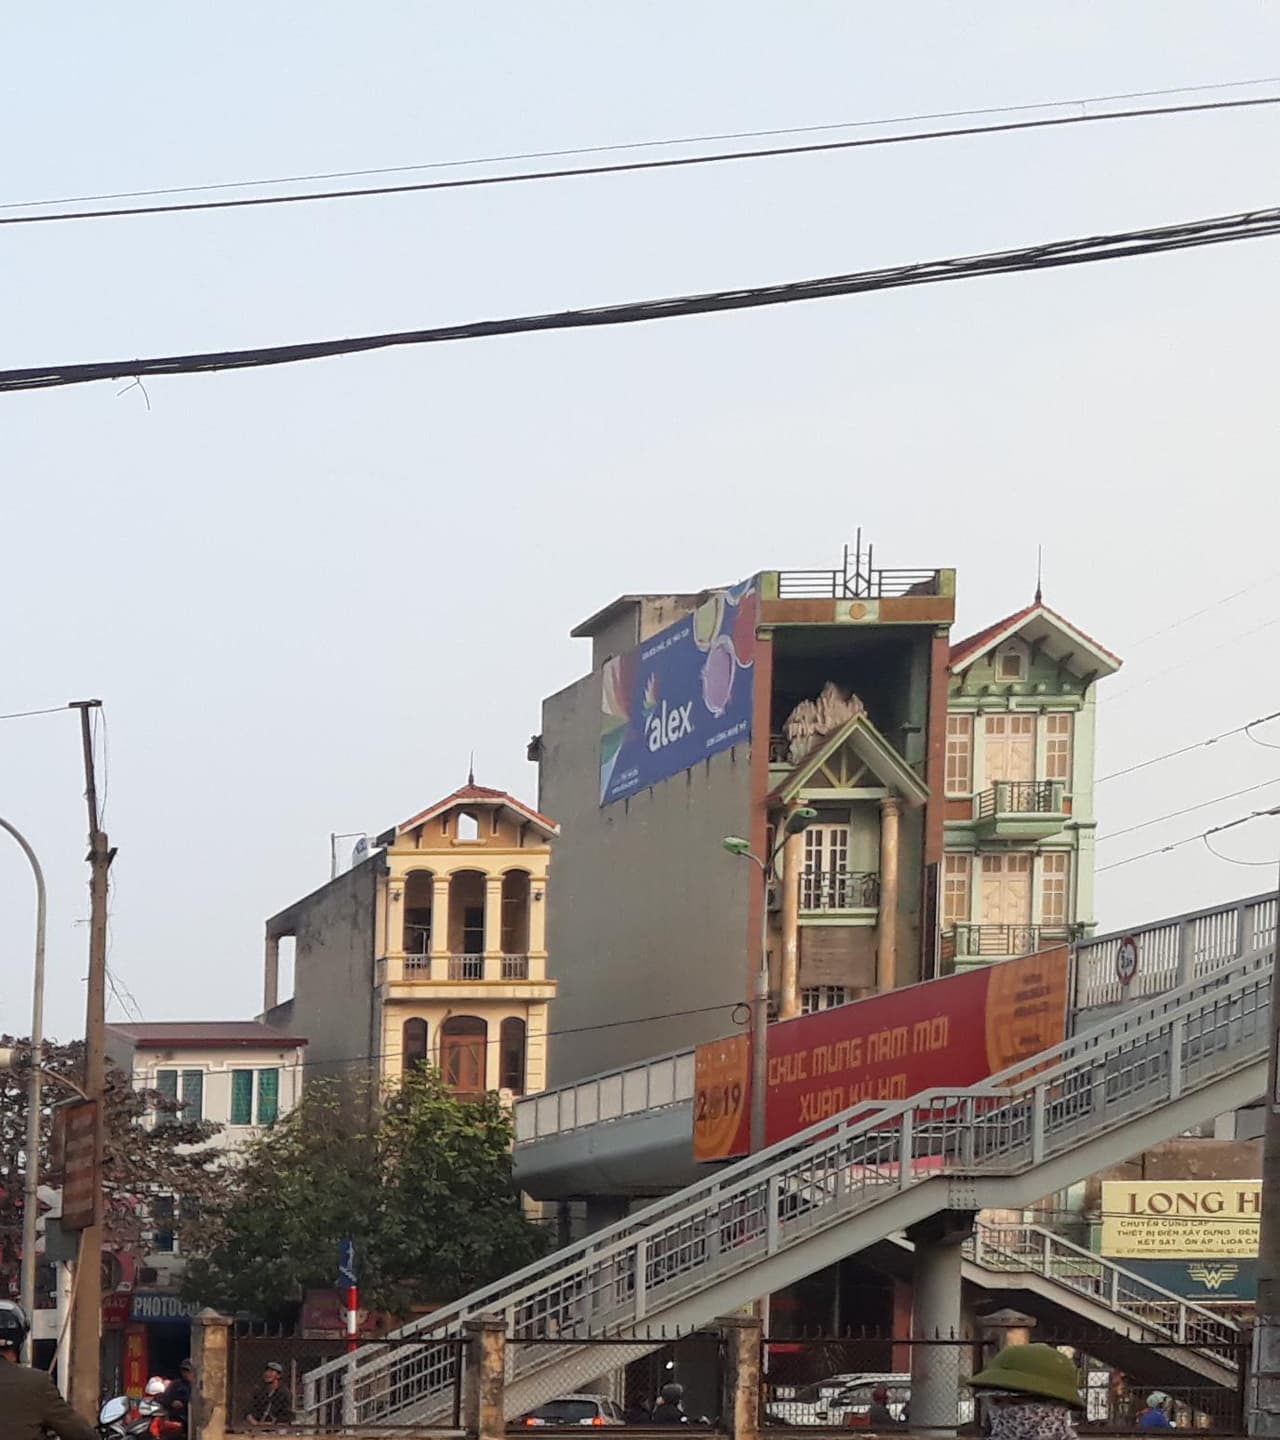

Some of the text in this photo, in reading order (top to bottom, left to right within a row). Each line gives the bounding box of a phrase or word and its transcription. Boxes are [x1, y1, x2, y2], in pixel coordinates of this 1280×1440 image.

[648, 699, 693, 752] alex
[1128, 1191, 1224, 1215] LONG
[133, 1297, 200, 1317] PHOTOCO
